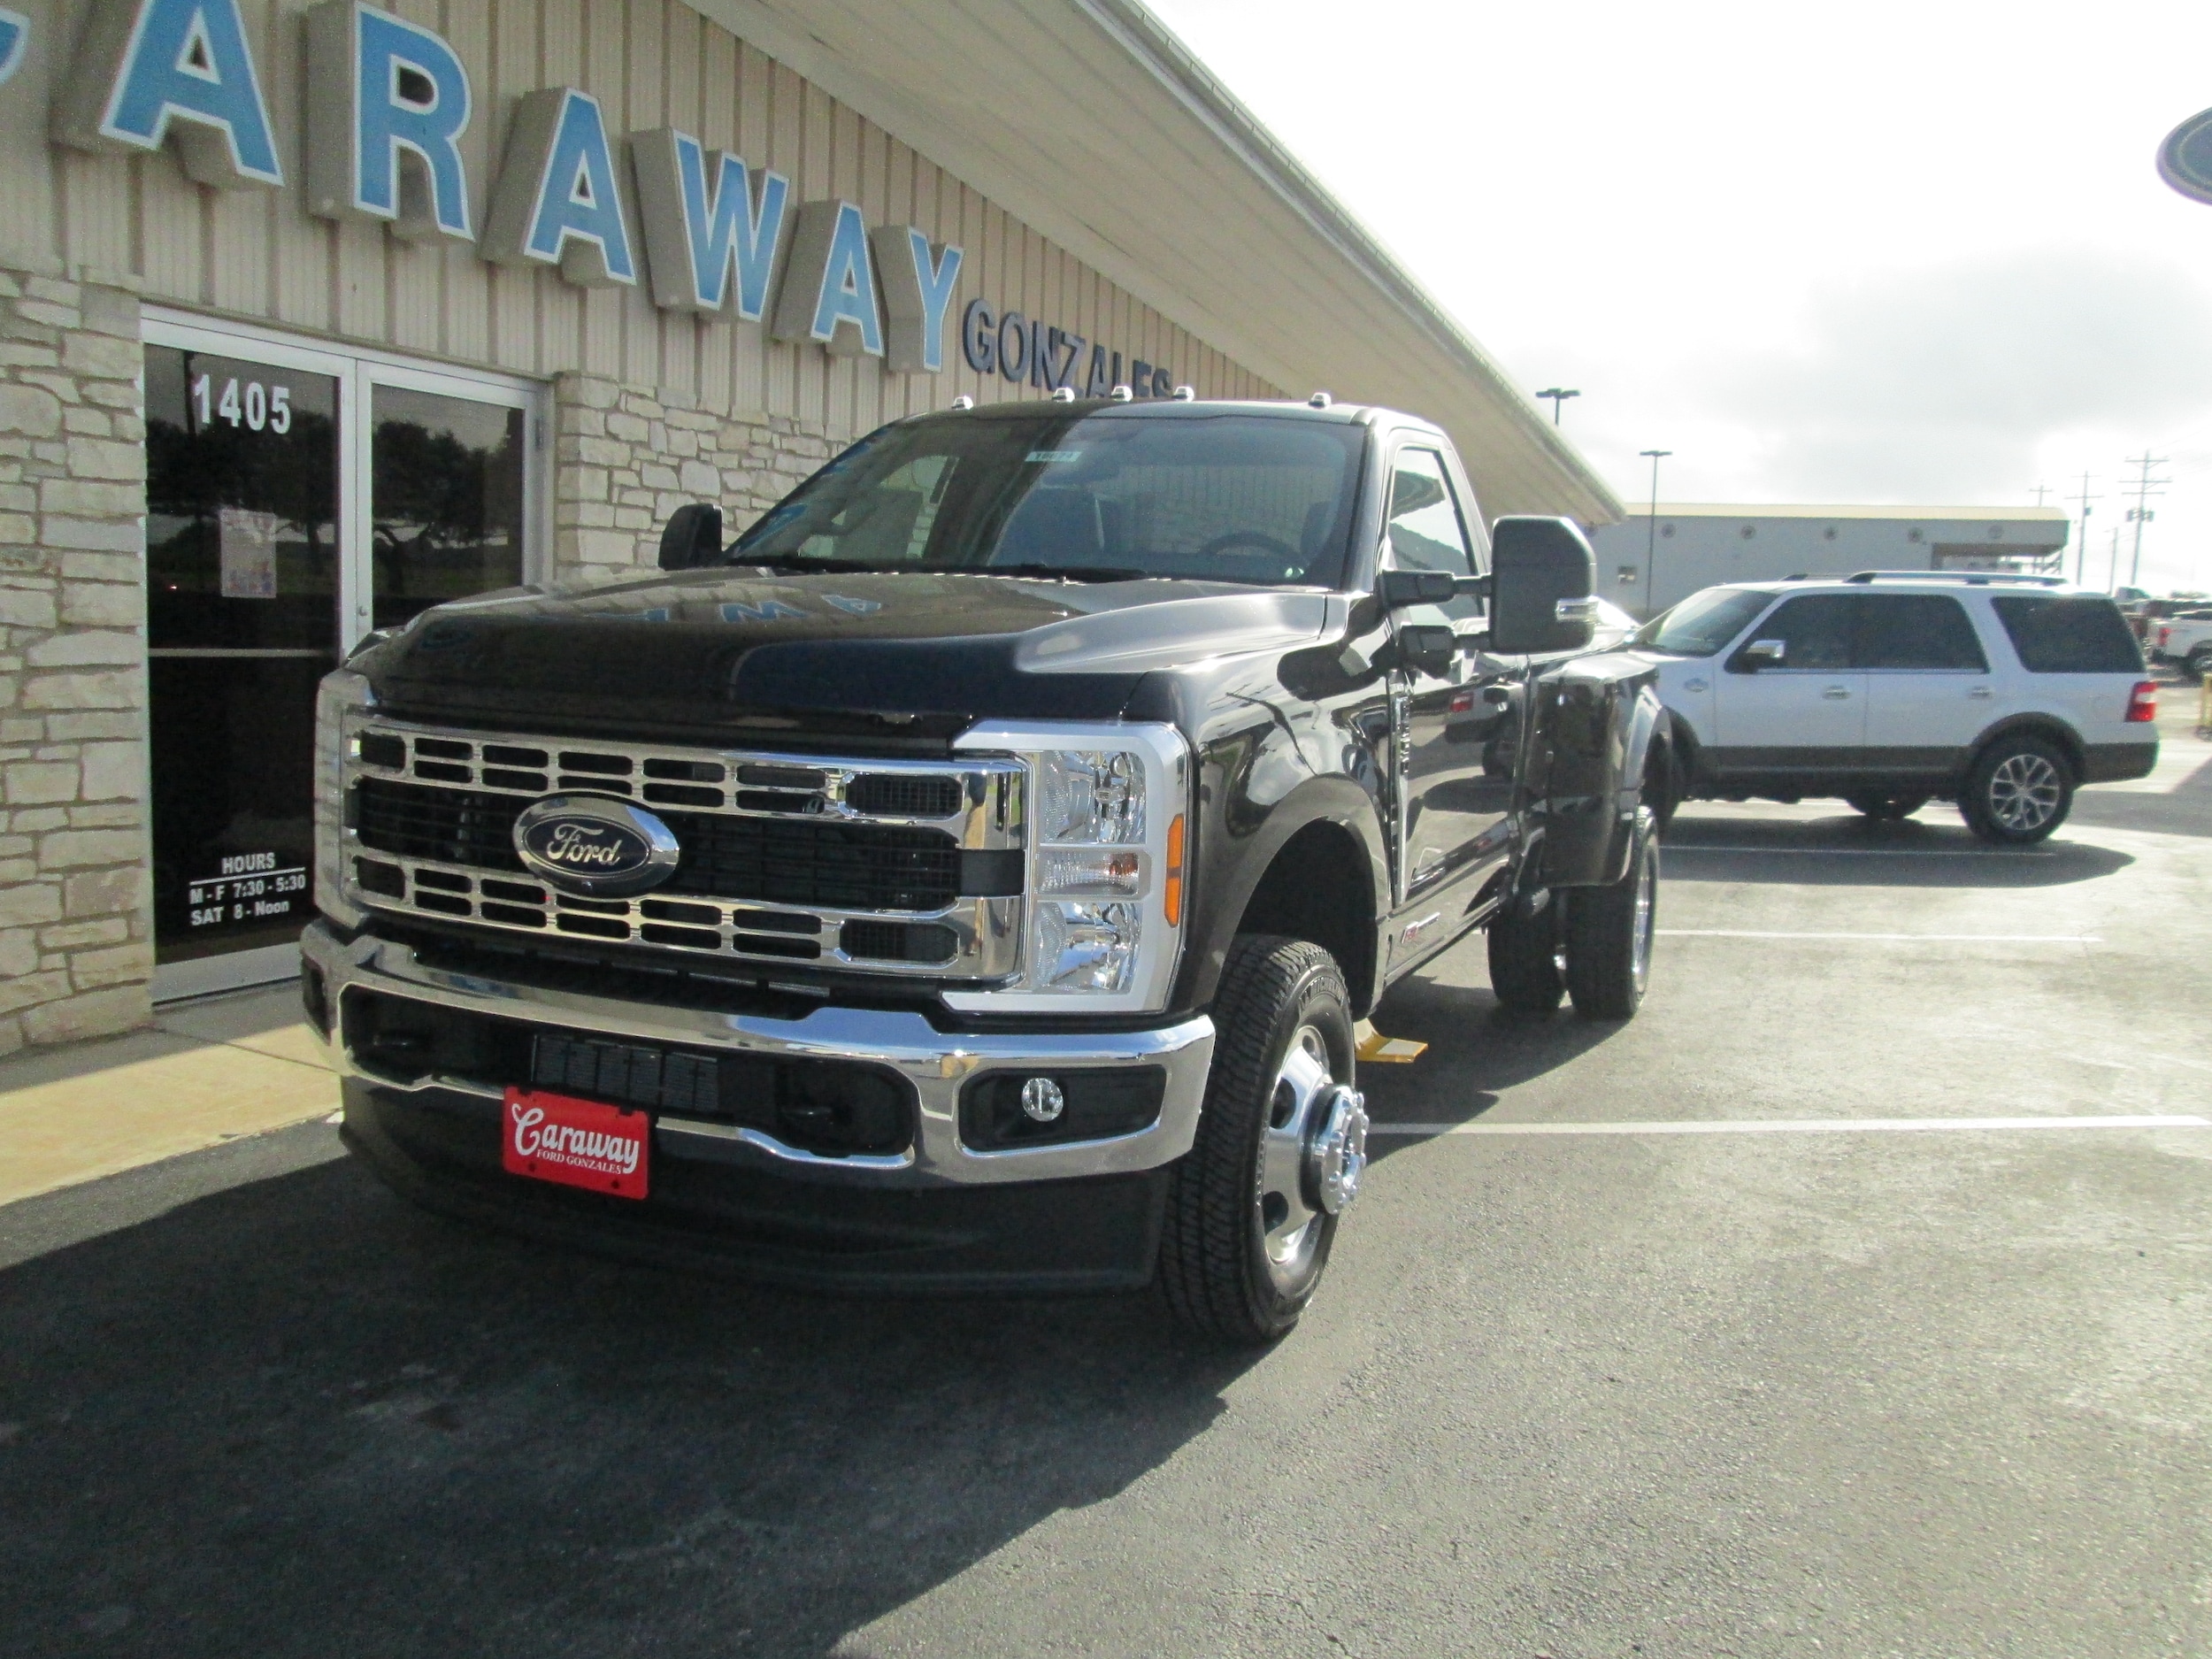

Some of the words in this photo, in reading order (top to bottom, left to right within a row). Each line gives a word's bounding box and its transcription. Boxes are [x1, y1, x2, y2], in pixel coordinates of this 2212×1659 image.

[0, 0, 964, 373] ARAWAY
[194, 373, 291, 434] 1405
[546, 823, 623, 866] Ford
[222, 852, 276, 874] HOURS
[233, 879, 265, 899] 7:30
[275, 874, 306, 893] 5:30
[190, 906, 224, 926] SAT
[255, 901, 290, 917] Noon
[511, 1103, 640, 1174] Caraway
[536, 1149, 565, 1163] FORD
[566, 1156, 622, 1175] GONZALES
